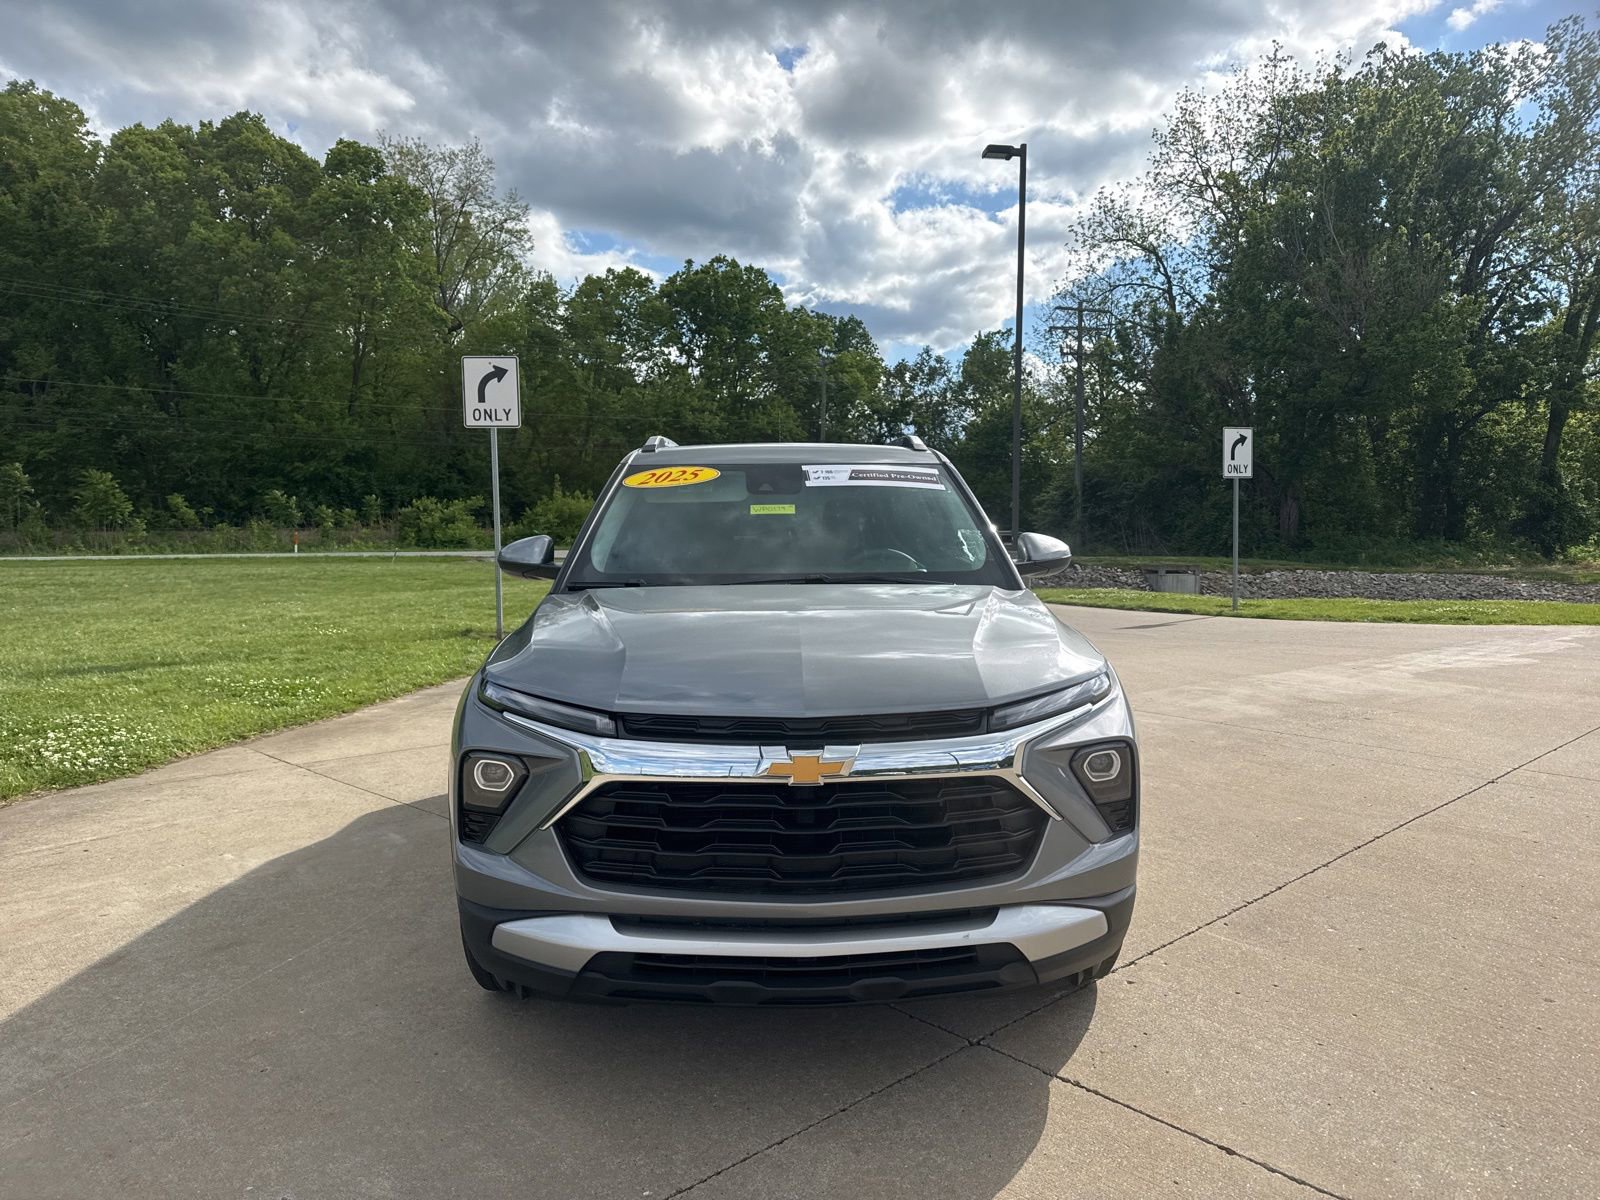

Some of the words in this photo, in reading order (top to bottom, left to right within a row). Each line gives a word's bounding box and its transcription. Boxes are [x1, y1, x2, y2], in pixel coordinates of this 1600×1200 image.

[472, 408, 511, 422] ONLY
[1227, 464, 1248, 474] ONLY
[636, 469, 704, 485] 2025
[851, 471, 889, 479] Certified
[890, 473, 937, 482] Pre-Owned
